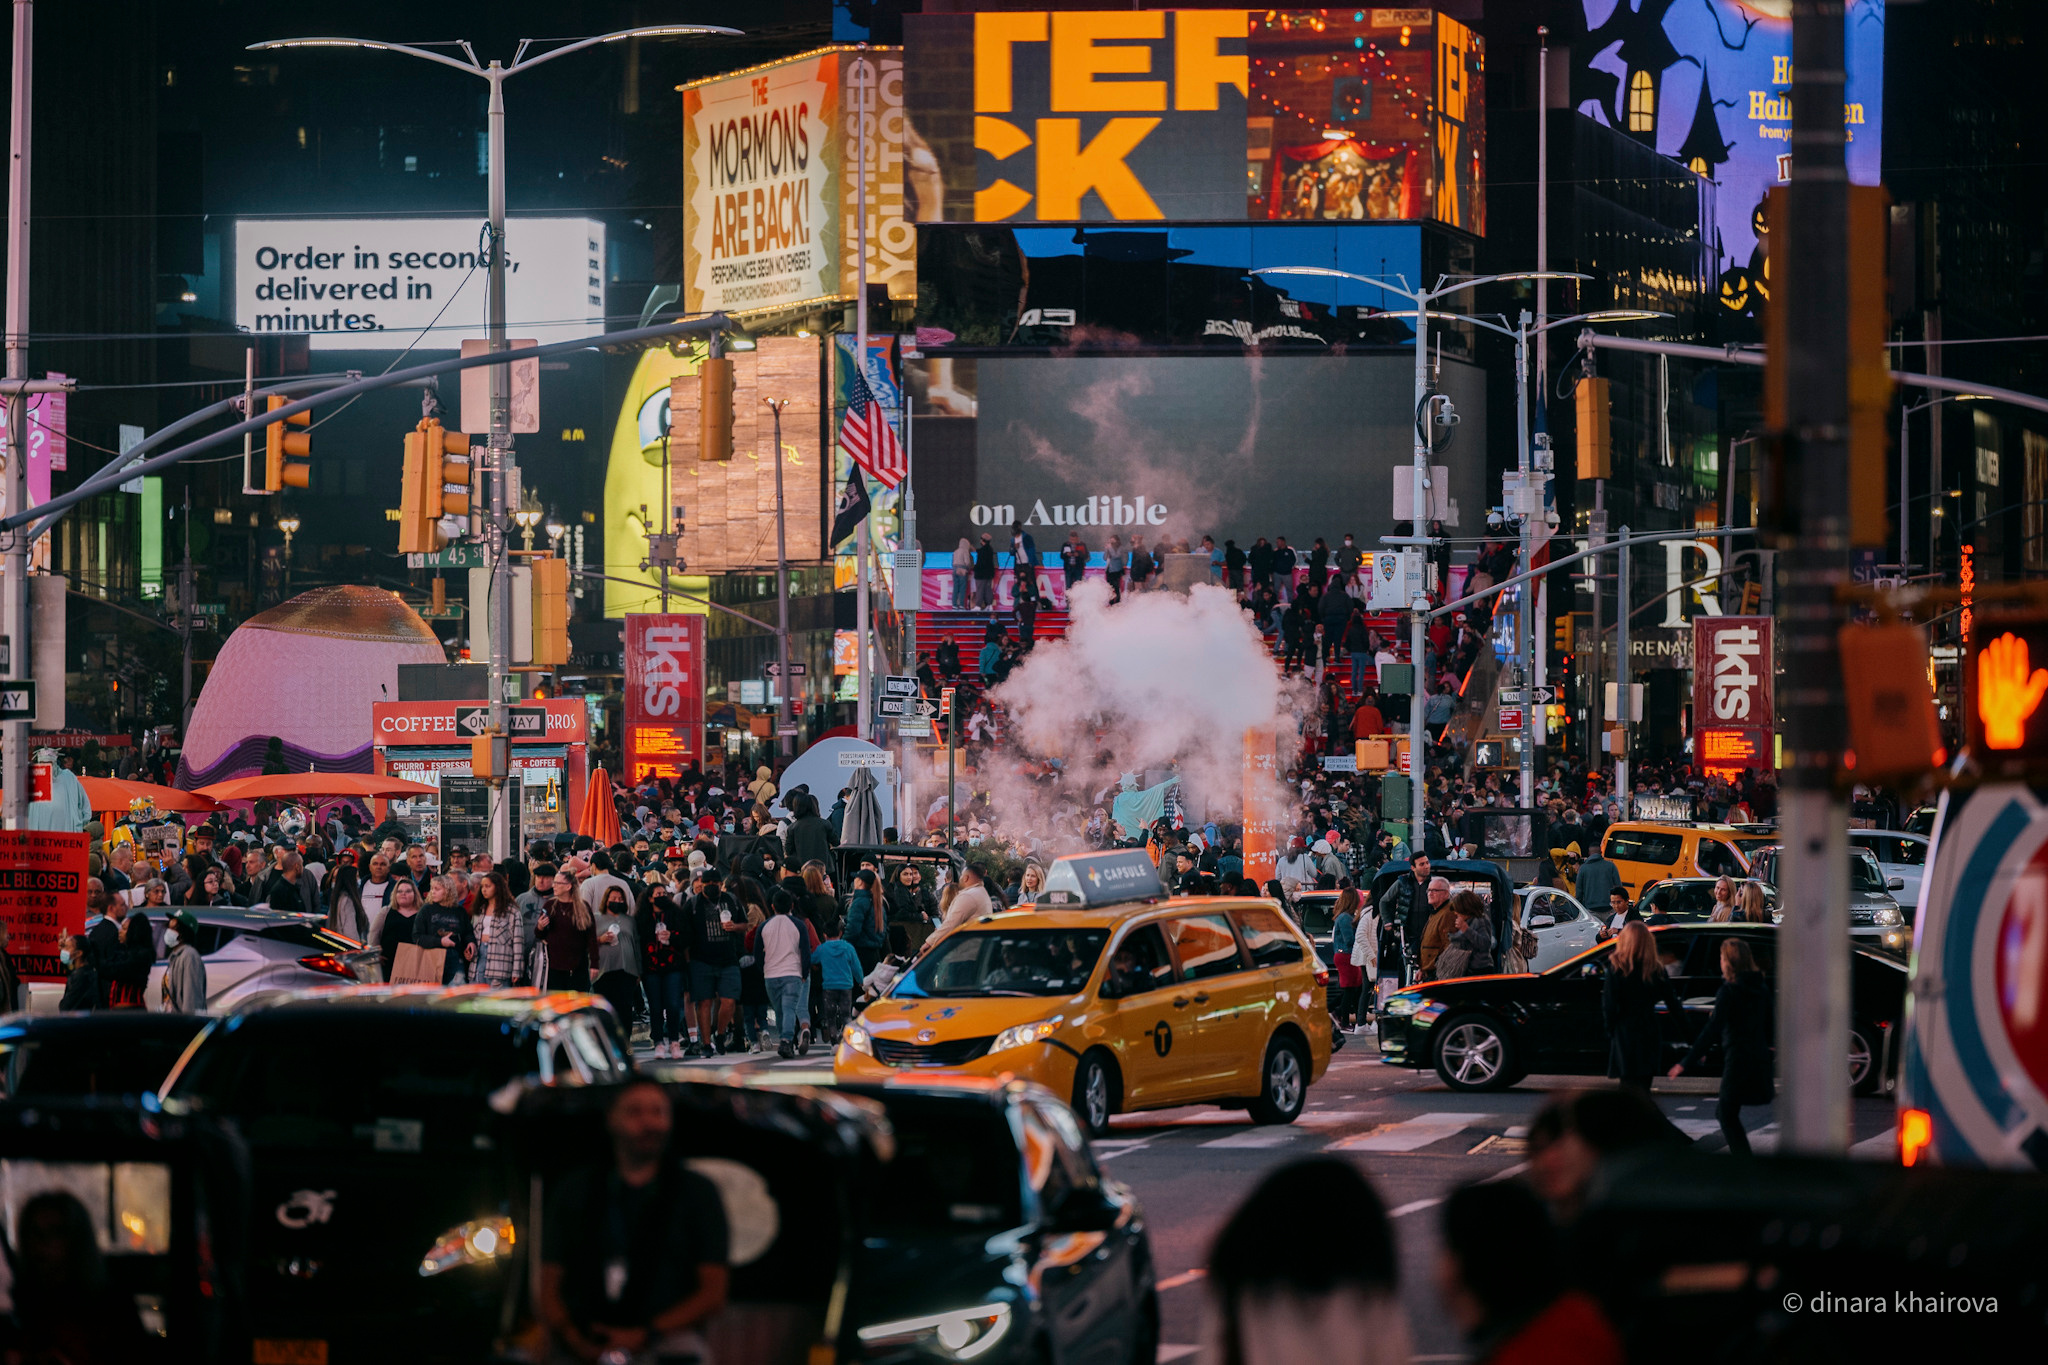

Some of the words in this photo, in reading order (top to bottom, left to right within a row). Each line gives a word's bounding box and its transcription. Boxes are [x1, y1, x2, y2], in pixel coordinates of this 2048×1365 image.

[752, 76, 768, 107] THE
[710, 102, 808, 188] MORMONS
[846, 60, 876, 205] MISSED
[711, 192, 749, 260] ARE
[754, 178, 810, 254] BACK!
[255, 246, 345, 270] Order
[354, 245, 380, 269] in
[711, 261, 757, 286] PERFORMANCES
[758, 258, 774, 278] BEGIN
[774, 251, 806, 276] NOVEMBER
[255, 276, 398, 300] delivered
[407, 276, 432, 300] in
[255, 307, 385, 331] minutes.
[969, 504, 1016, 526] on
[1023, 495, 1169, 526] Audible
[428, 550, 440, 564] W
[448, 547, 466, 564] 45
[473, 547, 483, 558] St
[644, 623, 690, 717] tkts
[1713, 625, 1760, 720] tkts
[381, 716, 455, 732] COFFEE
[547, 714, 576, 729] RROS
[469, 716, 488, 728] ON
[393, 762, 425, 771] CHURRO
[431, 761, 471, 770] ESPRESSO
[529, 758, 557, 768] COFFEE
[34, 838, 83, 848] BETWEEN
[1103, 864, 1147, 881] CAPSULE
